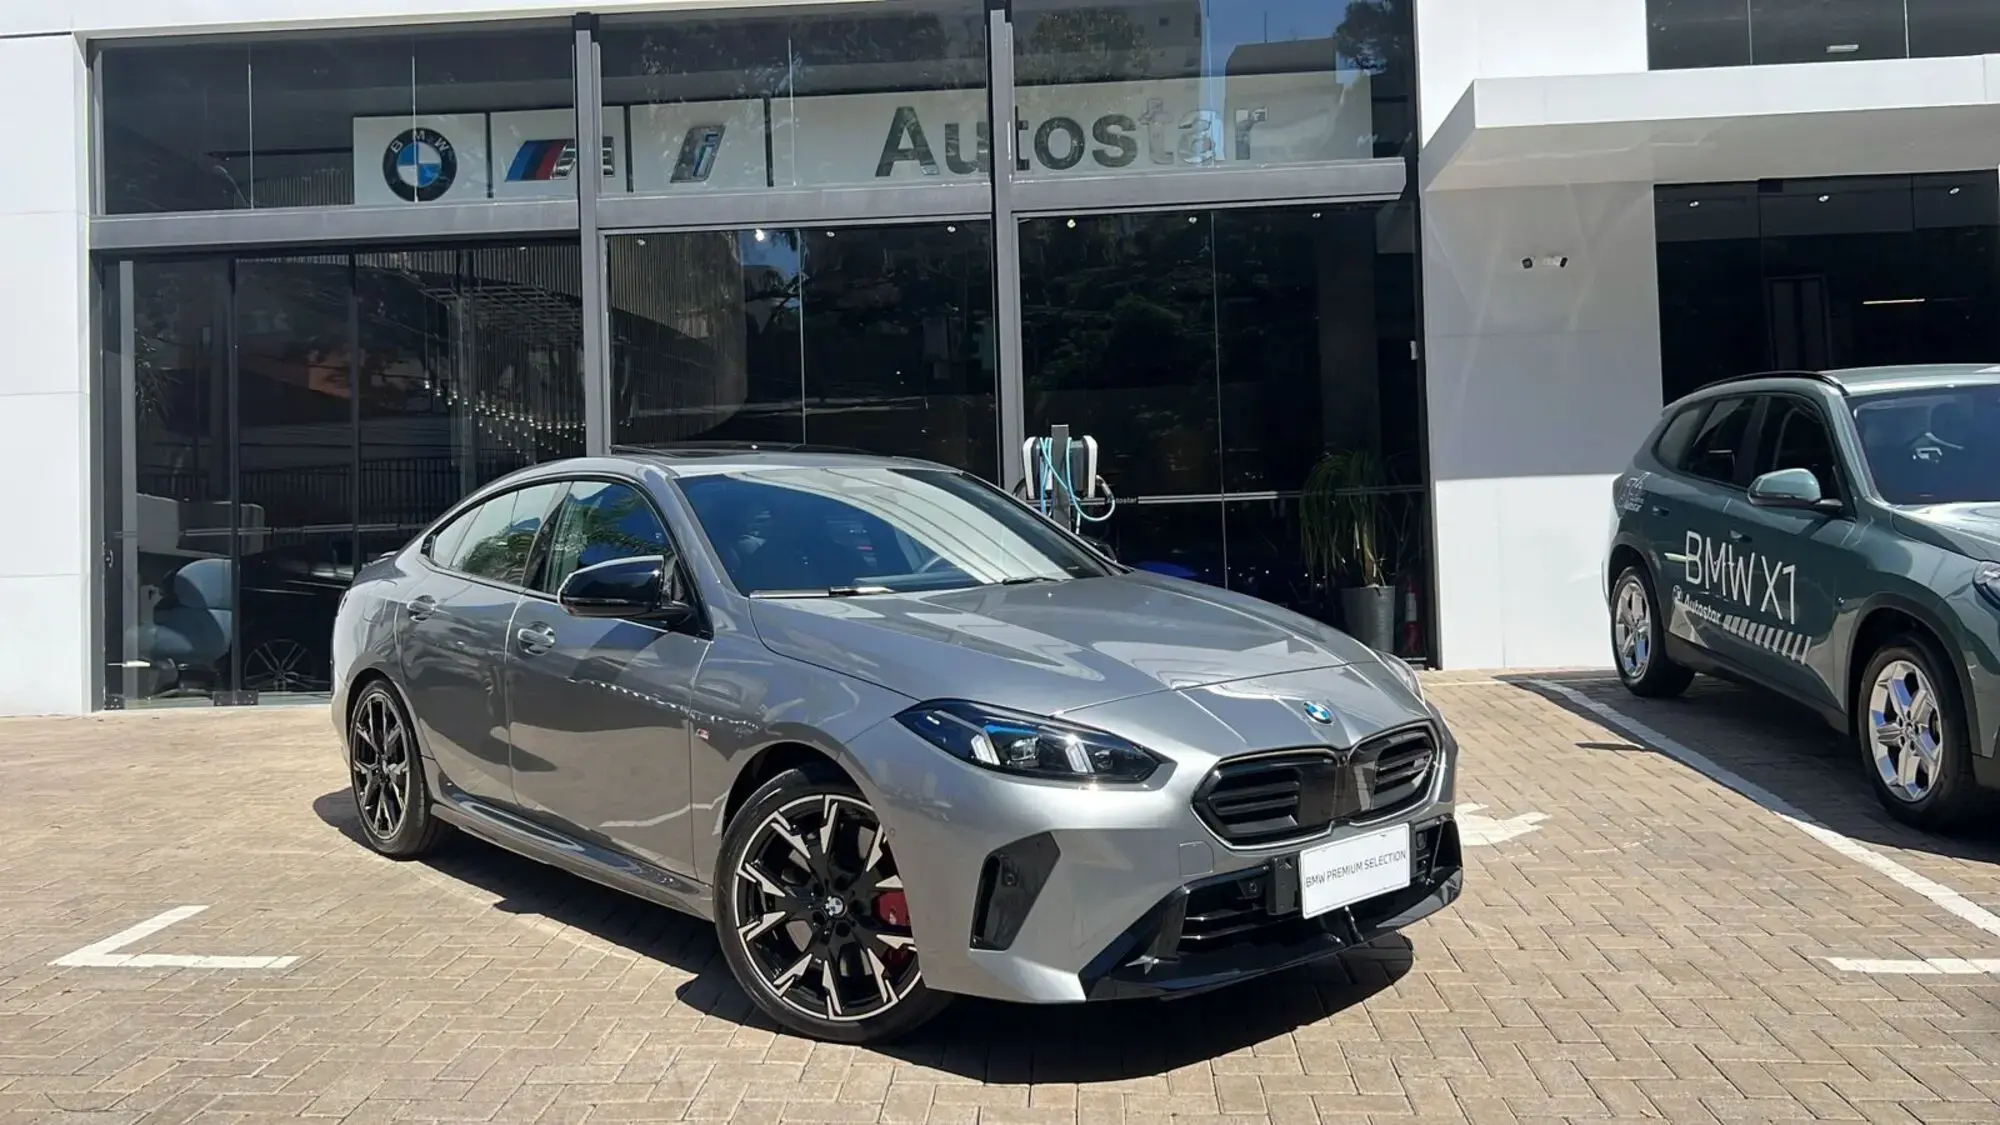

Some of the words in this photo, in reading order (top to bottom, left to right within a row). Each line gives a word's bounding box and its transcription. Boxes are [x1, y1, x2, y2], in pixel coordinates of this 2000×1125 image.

[1686, 530, 1756, 607] BMW
[1760, 555, 1796, 625] X1
[1683, 593, 1721, 625] Autostar
[1305, 873, 1326, 888] BMW
[1326, 861, 1363, 881] PREMIUM
[1364, 849, 1407, 870] SELECTION
